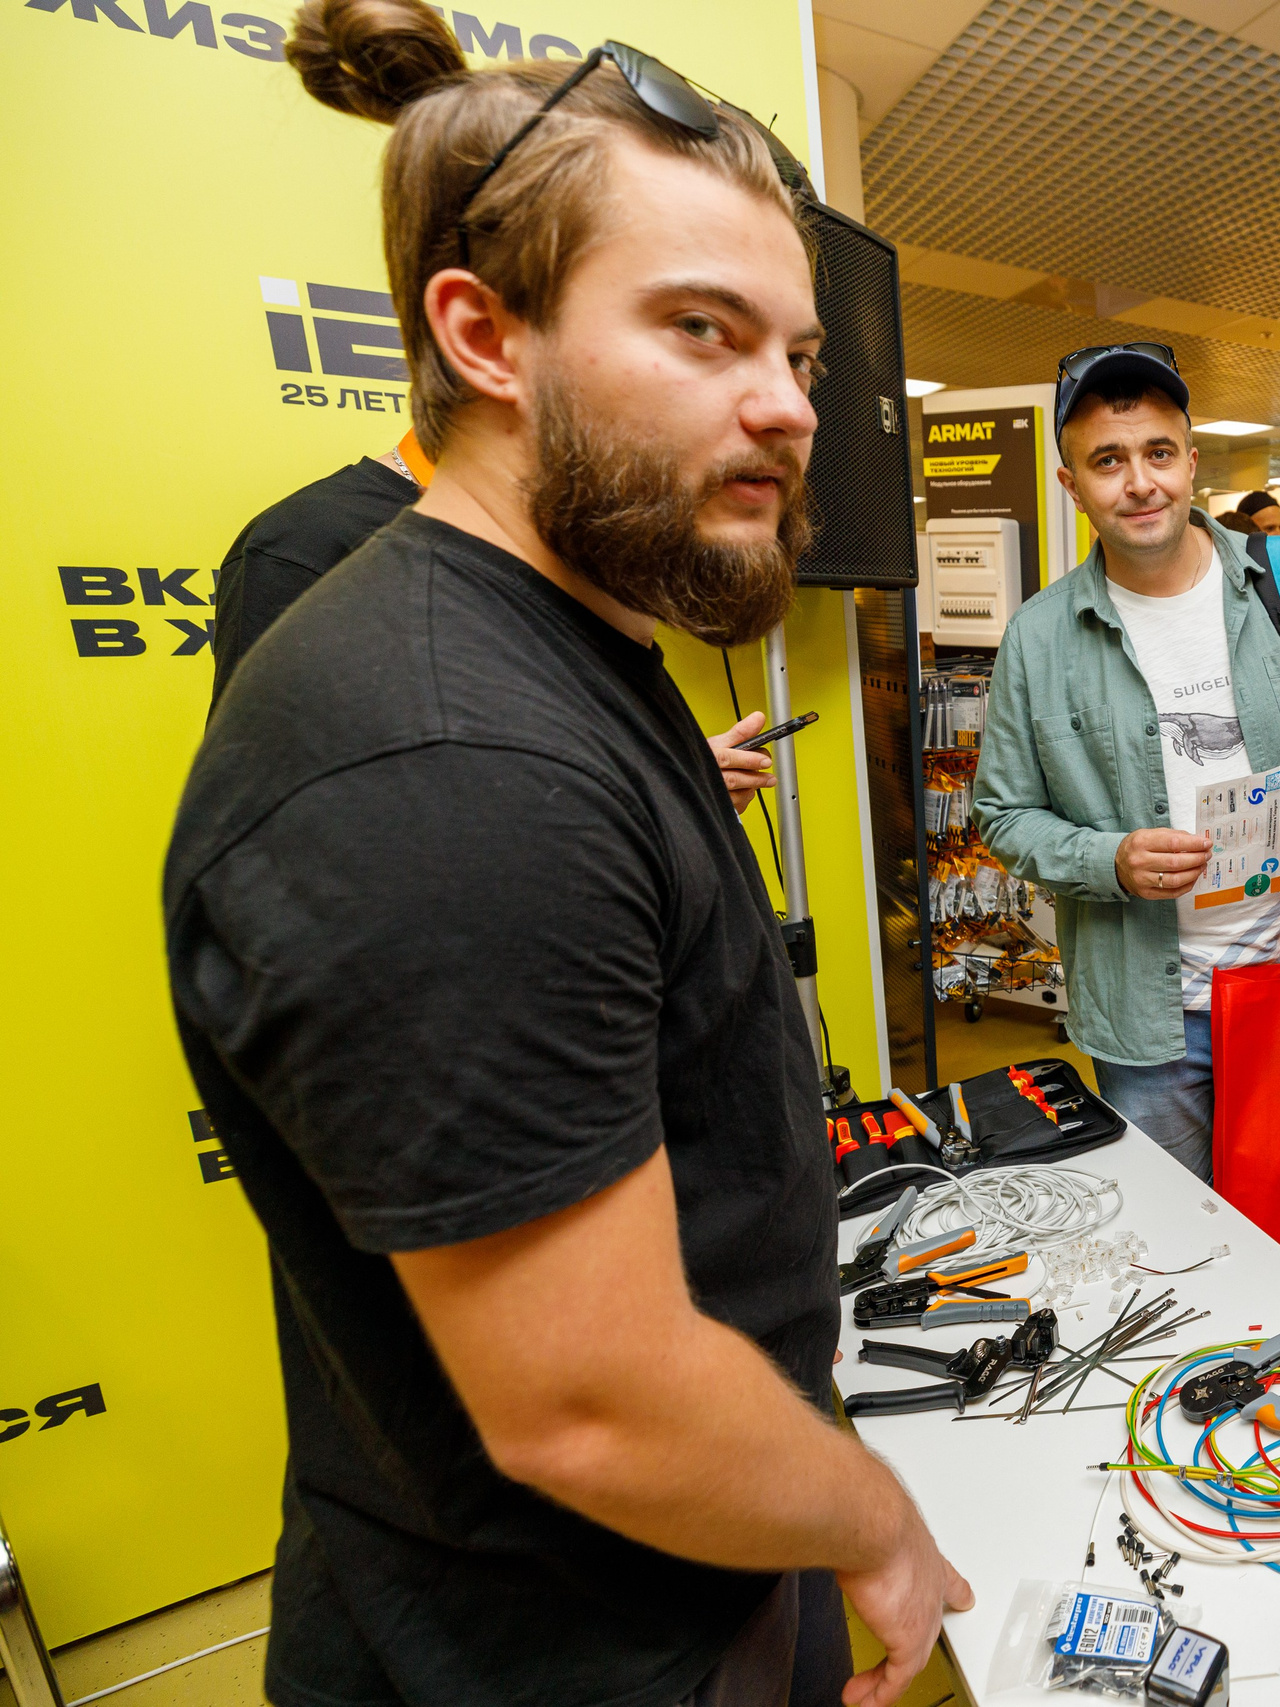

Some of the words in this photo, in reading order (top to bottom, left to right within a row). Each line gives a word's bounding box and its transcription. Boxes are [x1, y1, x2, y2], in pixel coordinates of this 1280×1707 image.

[280, 383, 329, 407] 25
[336, 388, 406, 414] ЛЕТ
[928, 421, 996, 443] ARMAT
[930, 465, 974, 473] ТЕХНОЛОГИЙ
[70, 619, 147, 657] В
[957, 730, 976, 747] BRITE
